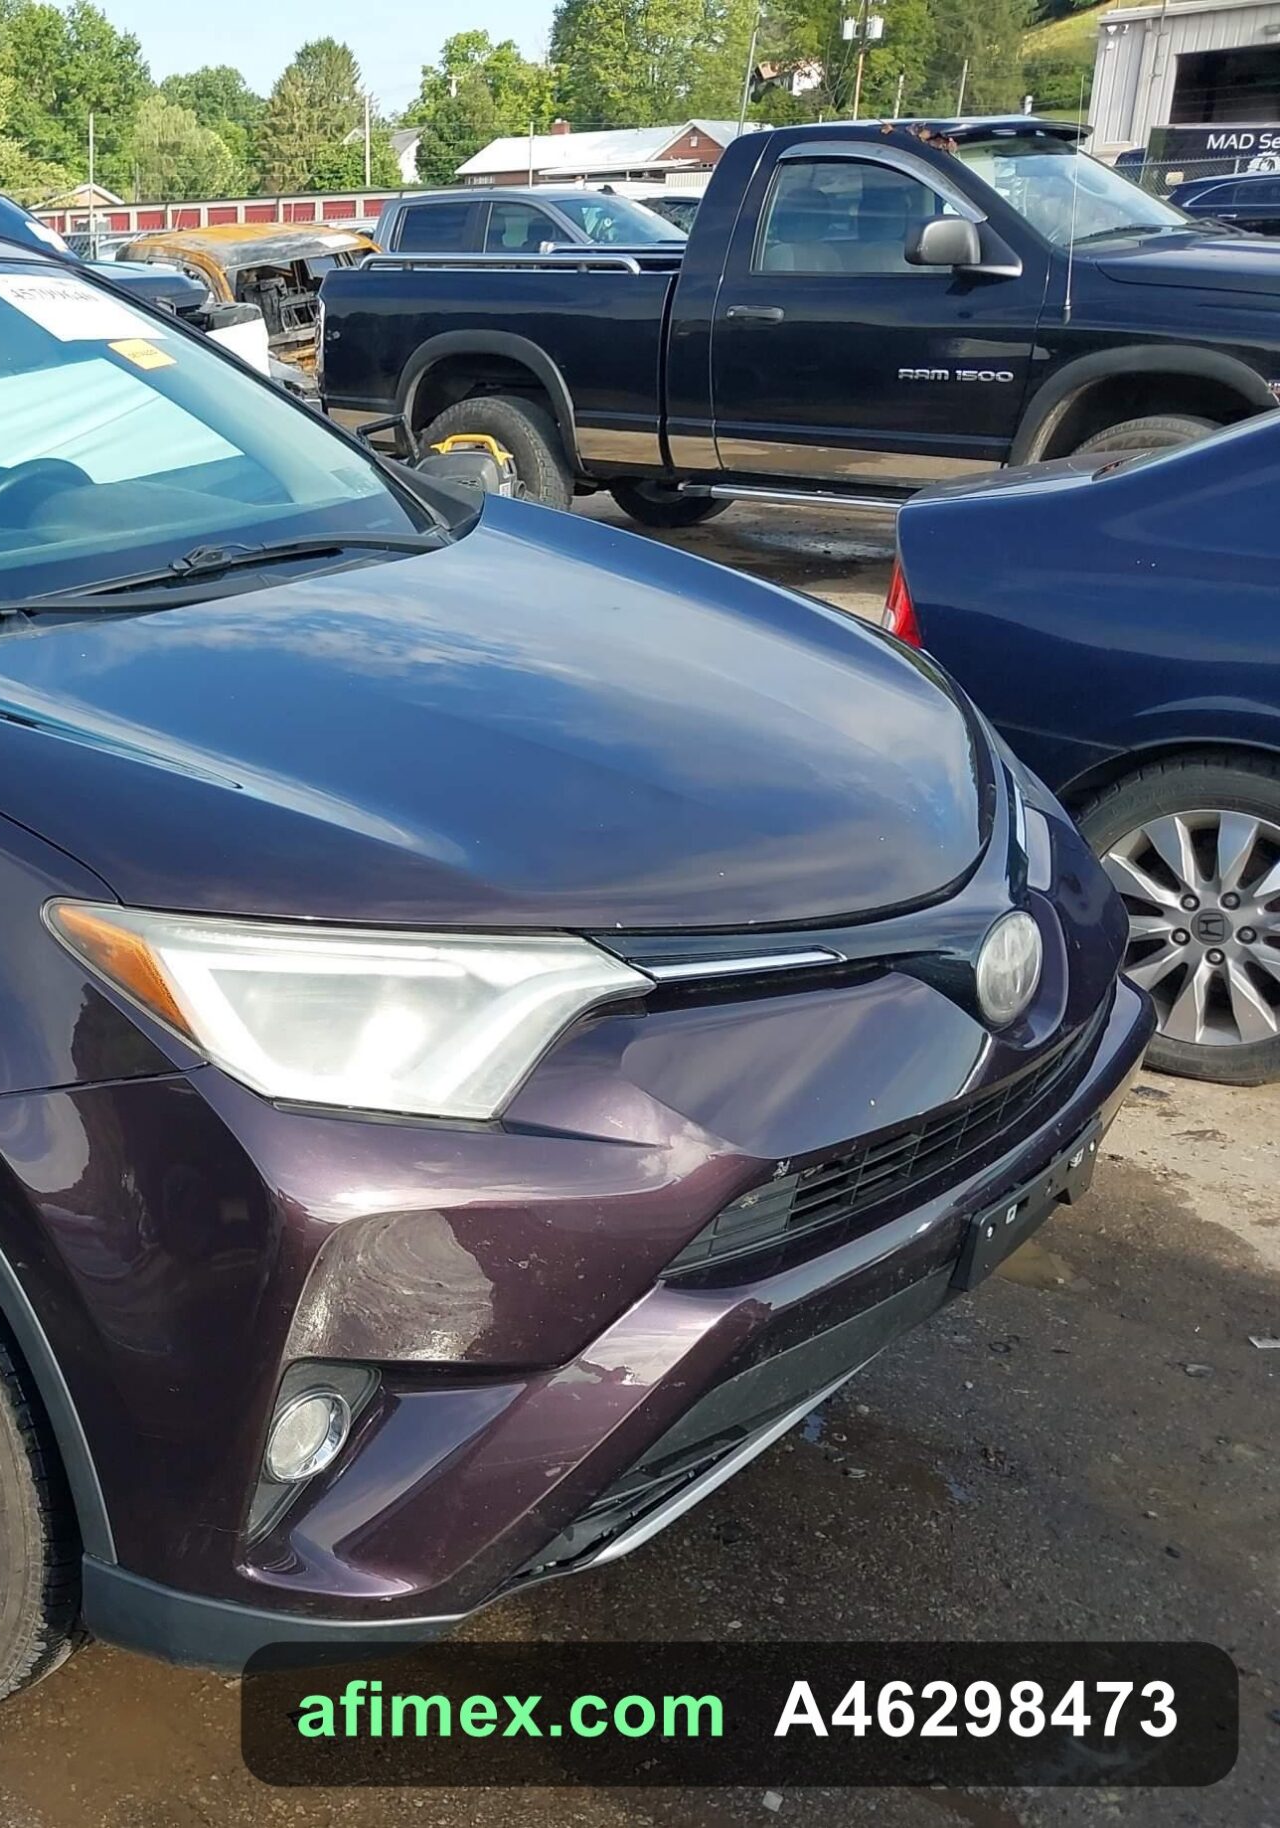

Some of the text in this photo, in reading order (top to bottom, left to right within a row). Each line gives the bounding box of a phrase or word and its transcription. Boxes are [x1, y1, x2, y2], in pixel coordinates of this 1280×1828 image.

[1206, 133, 1254, 150] MAD
[898, 368, 1014, 382] RAM 1500
